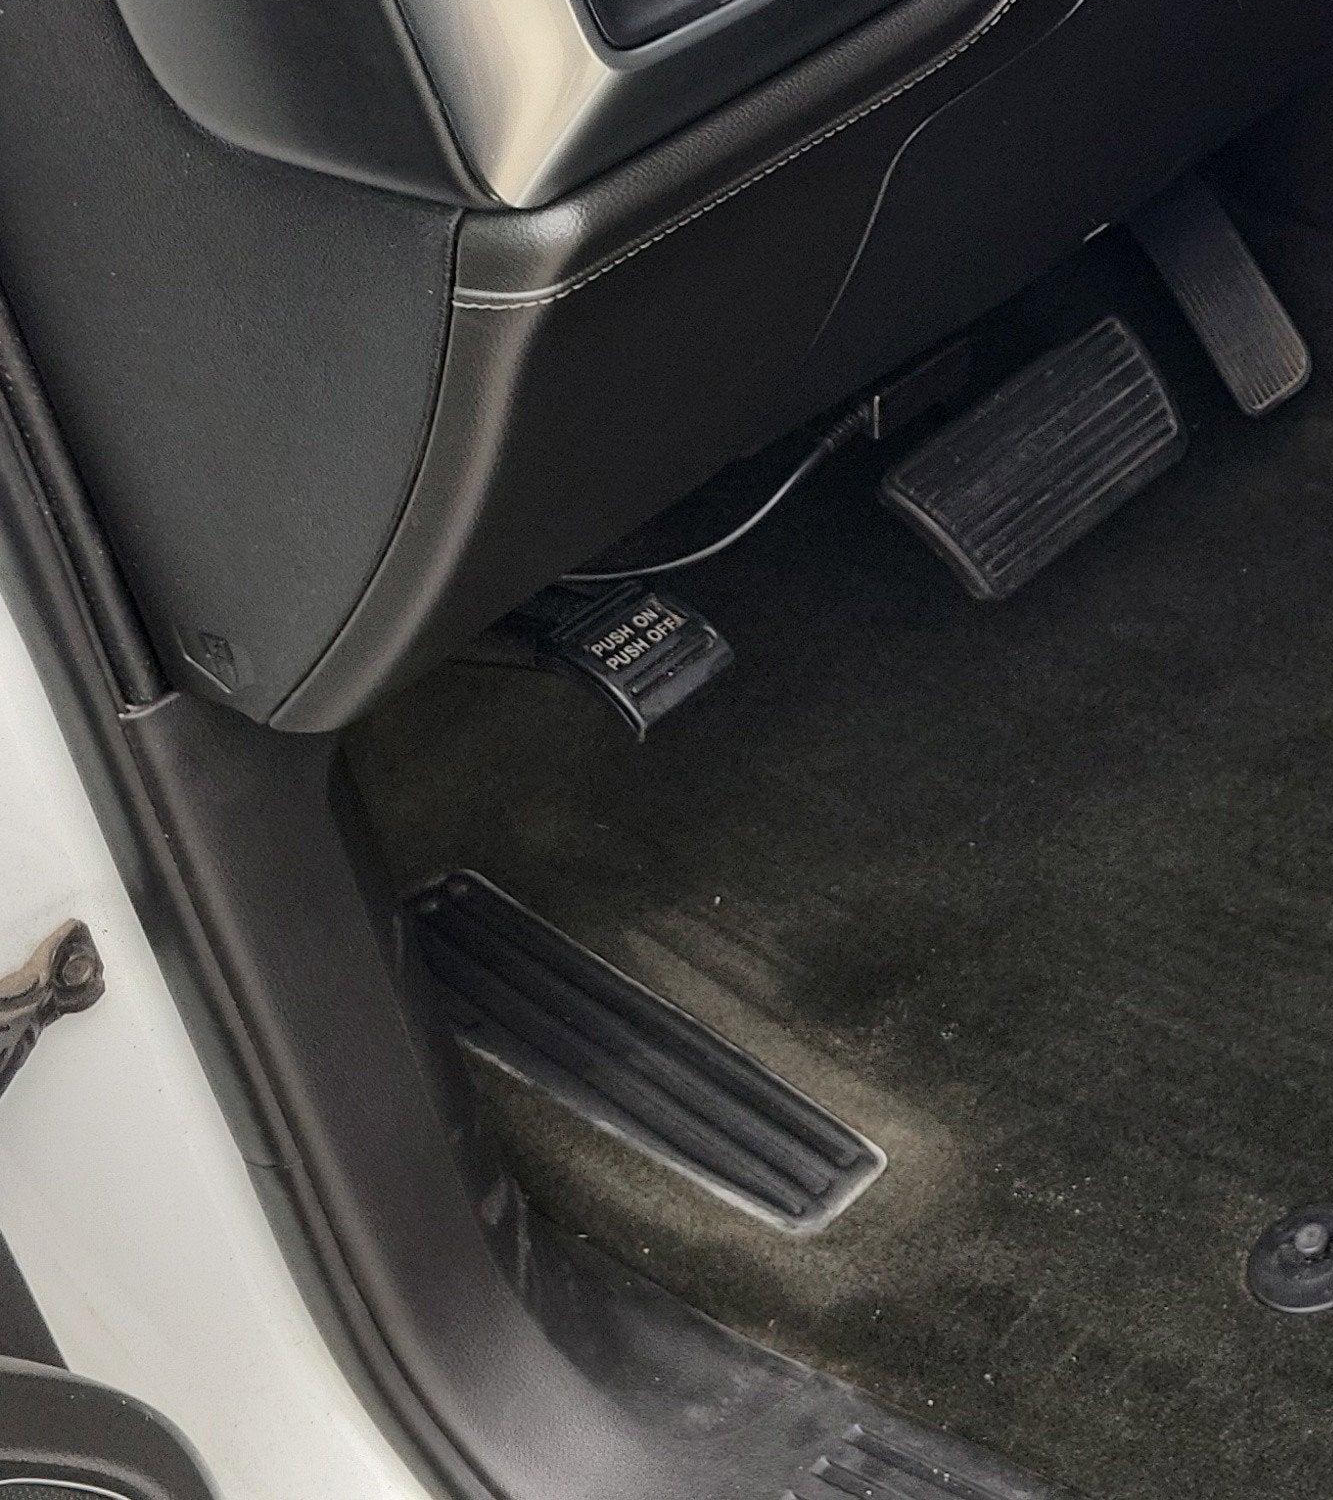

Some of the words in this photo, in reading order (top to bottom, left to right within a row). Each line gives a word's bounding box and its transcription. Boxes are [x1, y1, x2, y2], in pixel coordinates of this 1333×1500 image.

[591, 624, 636, 657] PUSH
[632, 607, 659, 628] ON
[605, 638, 651, 671] PUSH
[645, 616, 676, 642] OFF
